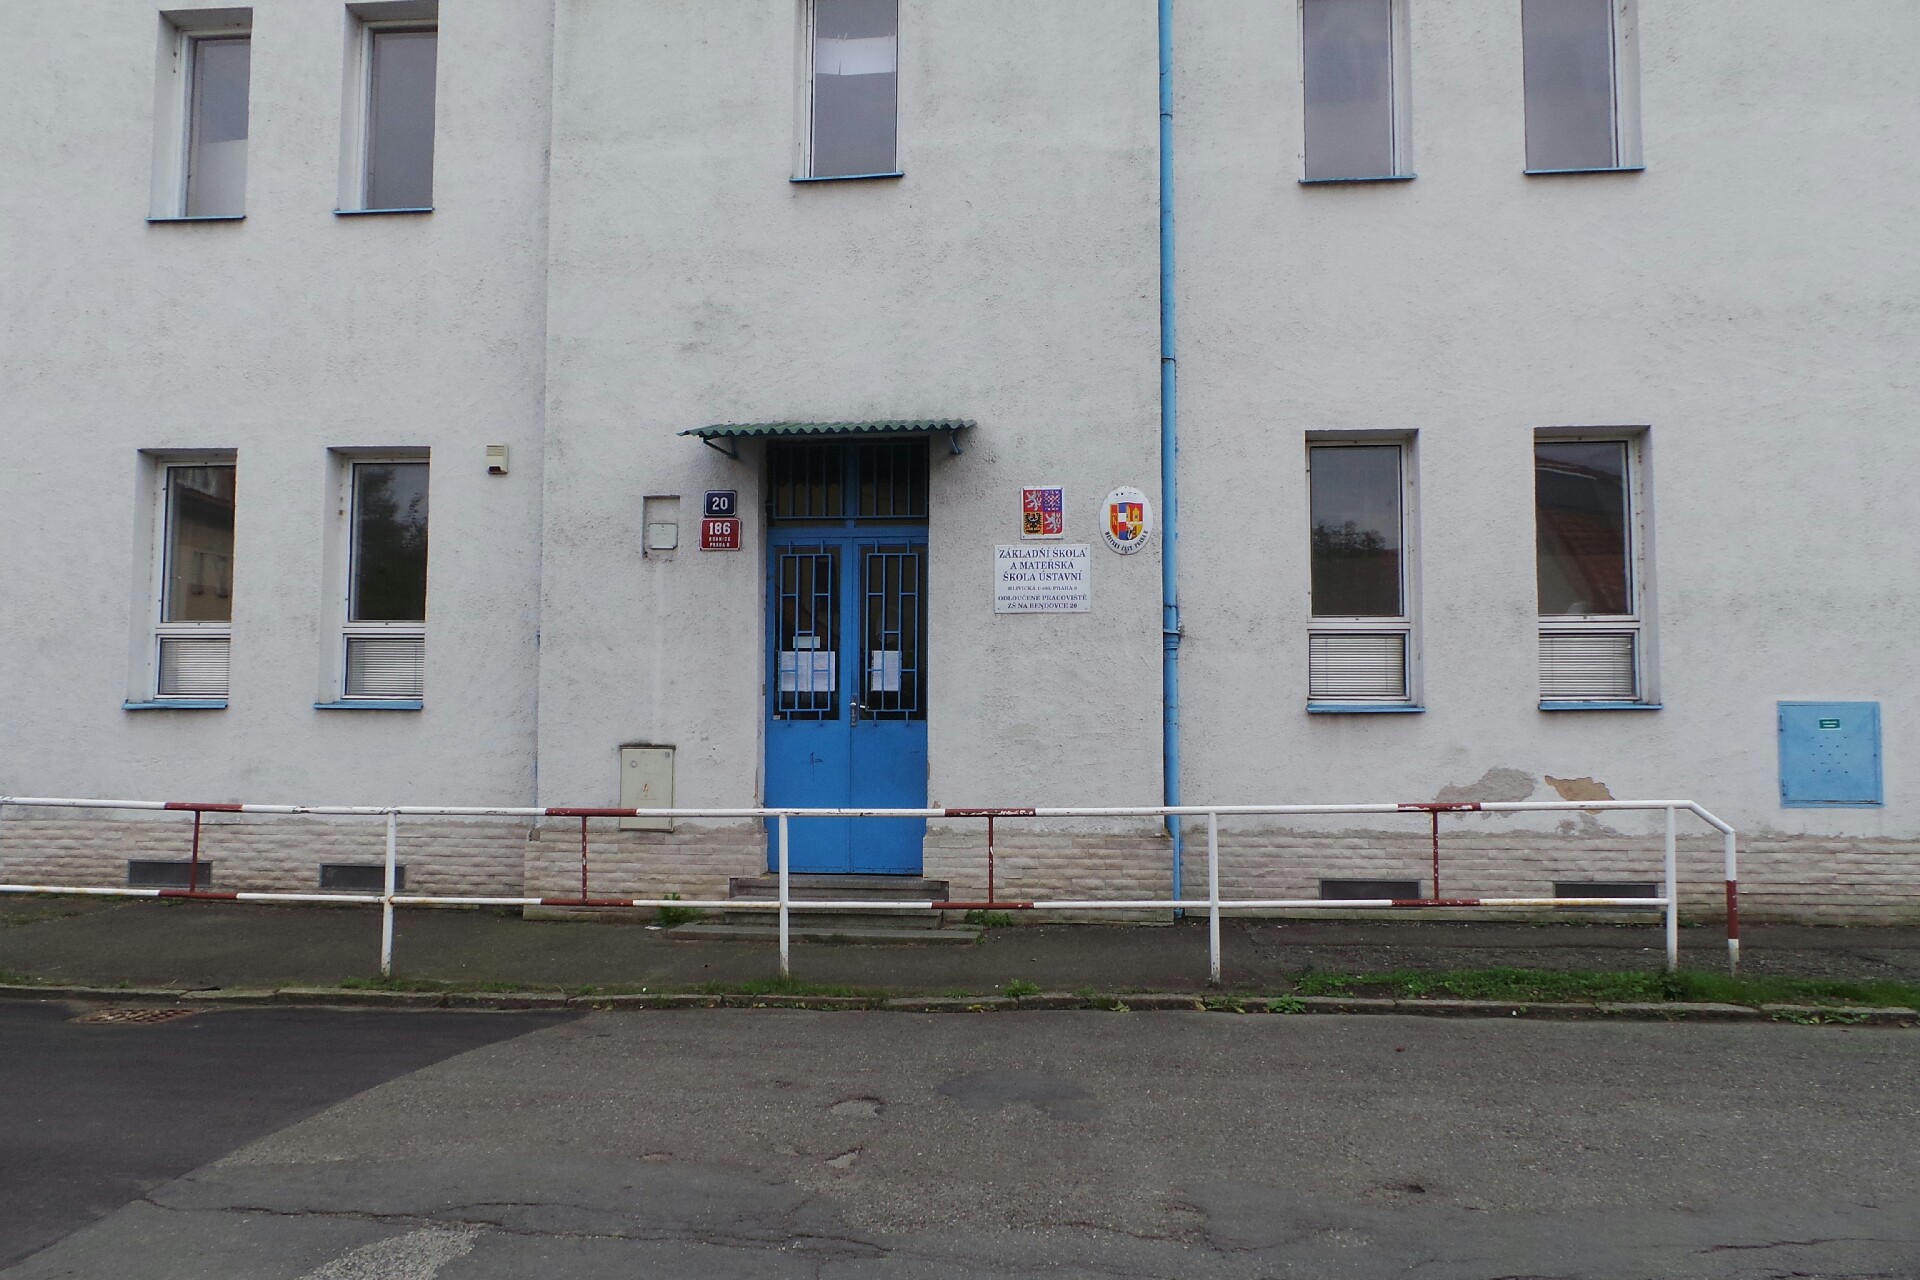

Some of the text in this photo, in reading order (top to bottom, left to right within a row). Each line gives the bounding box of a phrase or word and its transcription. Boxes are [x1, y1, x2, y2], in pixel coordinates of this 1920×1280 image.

[712, 497, 728, 510] 20
[709, 522, 730, 534] 186
[999, 547, 1086, 558] ZÁKLADNÍ ŠKOLA
[1010, 559, 1074, 570] A MATEŘSKÁ
[1003, 570, 1082, 581] ŠKOLA ÚSTAVNÍ
